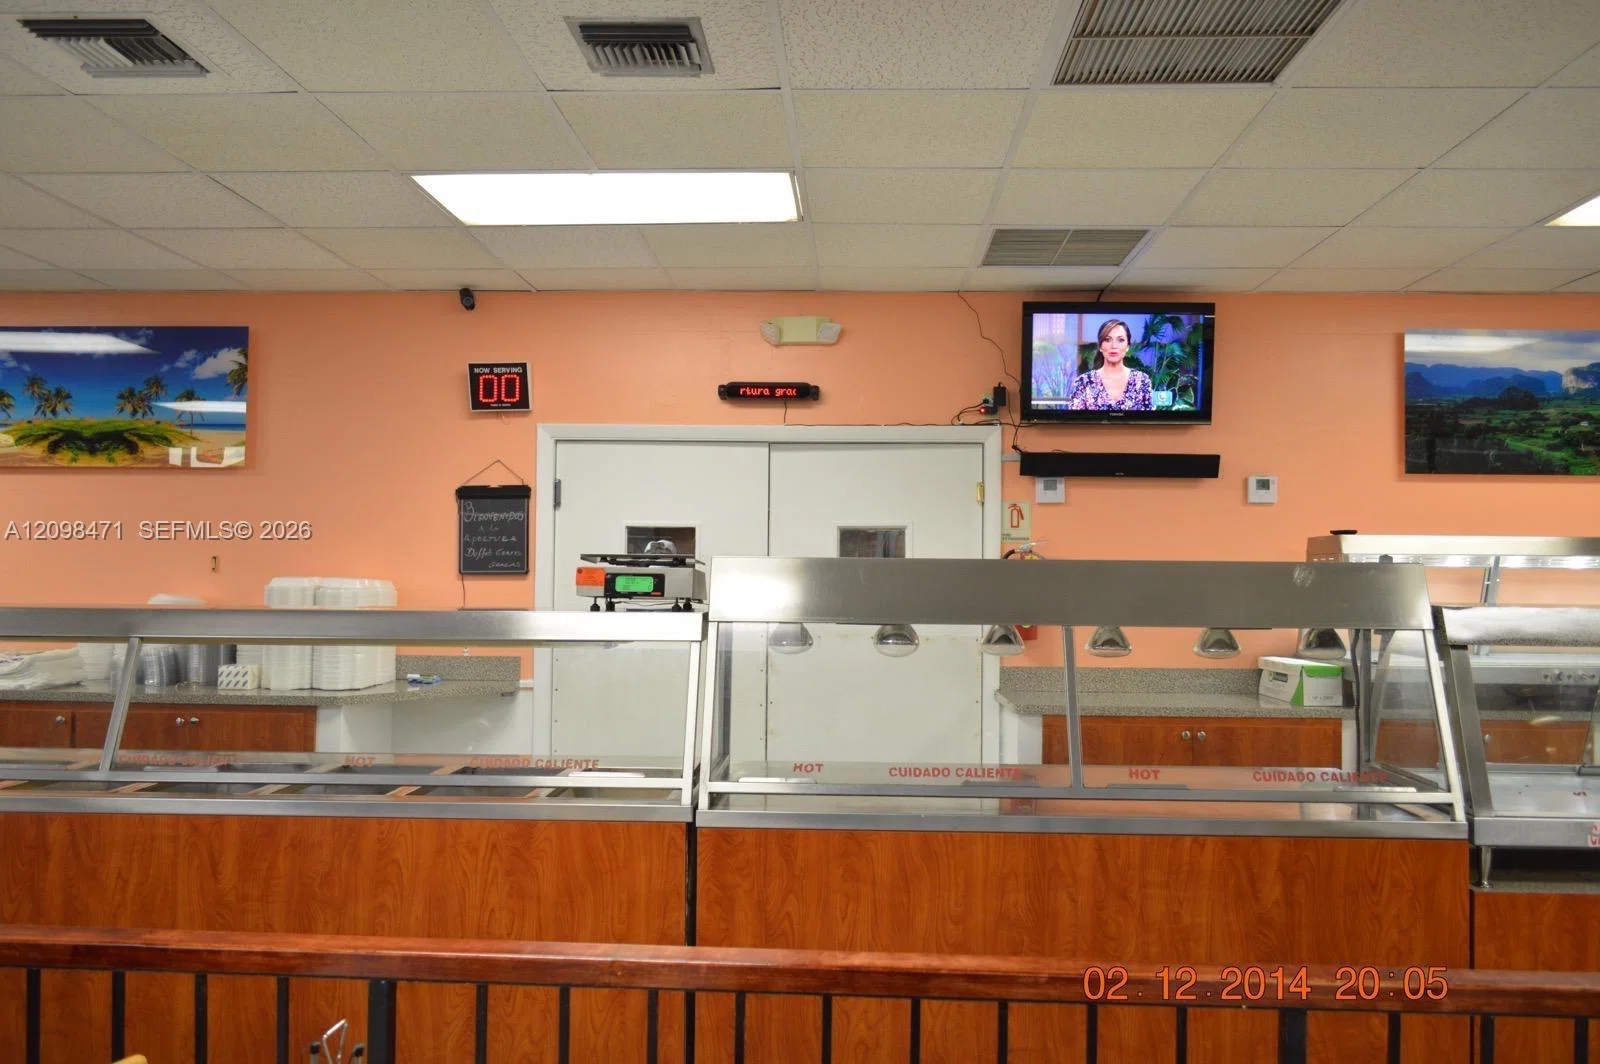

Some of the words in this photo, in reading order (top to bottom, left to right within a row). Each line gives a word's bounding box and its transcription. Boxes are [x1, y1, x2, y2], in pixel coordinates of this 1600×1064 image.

[493, 366, 523, 374] SERVING
[479, 374, 520, 403] 00
[344, 755, 375, 768] HOT
[469, 758, 531, 769] CUIDADO
[534, 758, 600, 770] CALIENTE
[792, 763, 824, 774] HOT
[888, 766, 951, 778] CUIDADO
[955, 767, 1022, 780] CALIENTE
[1128, 768, 1161, 780] HOT
[1252, 770, 1317, 783] CUIDADO
